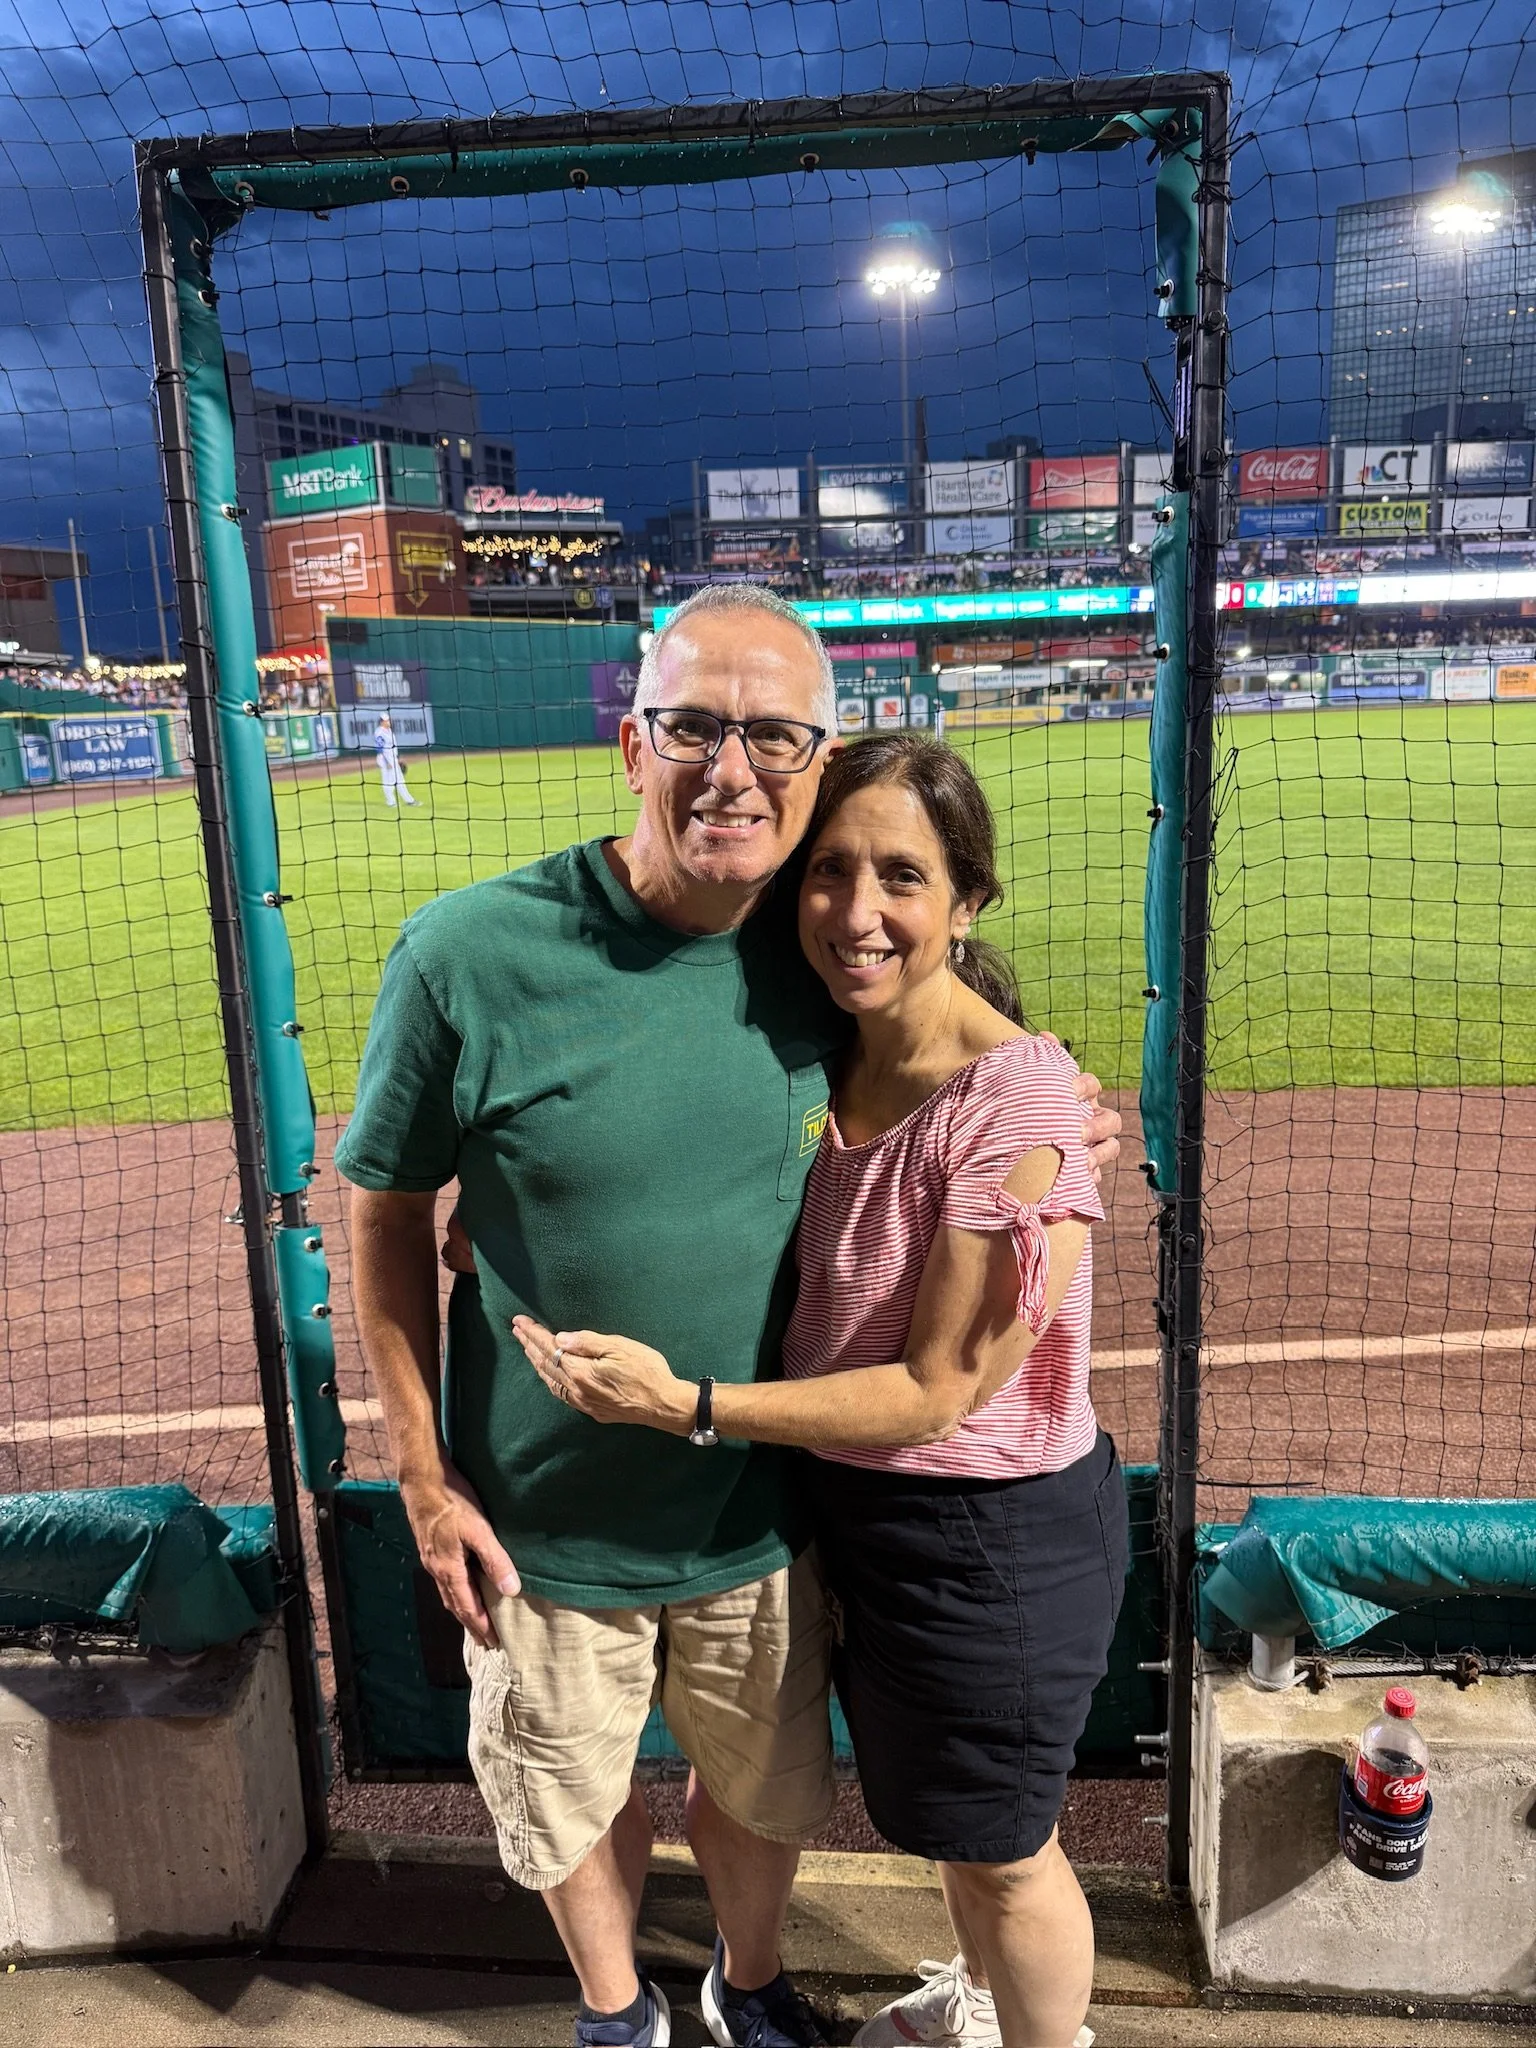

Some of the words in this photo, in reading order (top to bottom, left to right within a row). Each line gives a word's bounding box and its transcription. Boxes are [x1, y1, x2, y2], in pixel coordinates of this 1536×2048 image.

[468, 485, 605, 513] Budweiser
[1346, 505, 1422, 520] CUSTOM
[84, 737, 128, 753] LAW
[1375, 1842, 1408, 1854] DRIVE
[1386, 1838, 1417, 1847] DON'T
